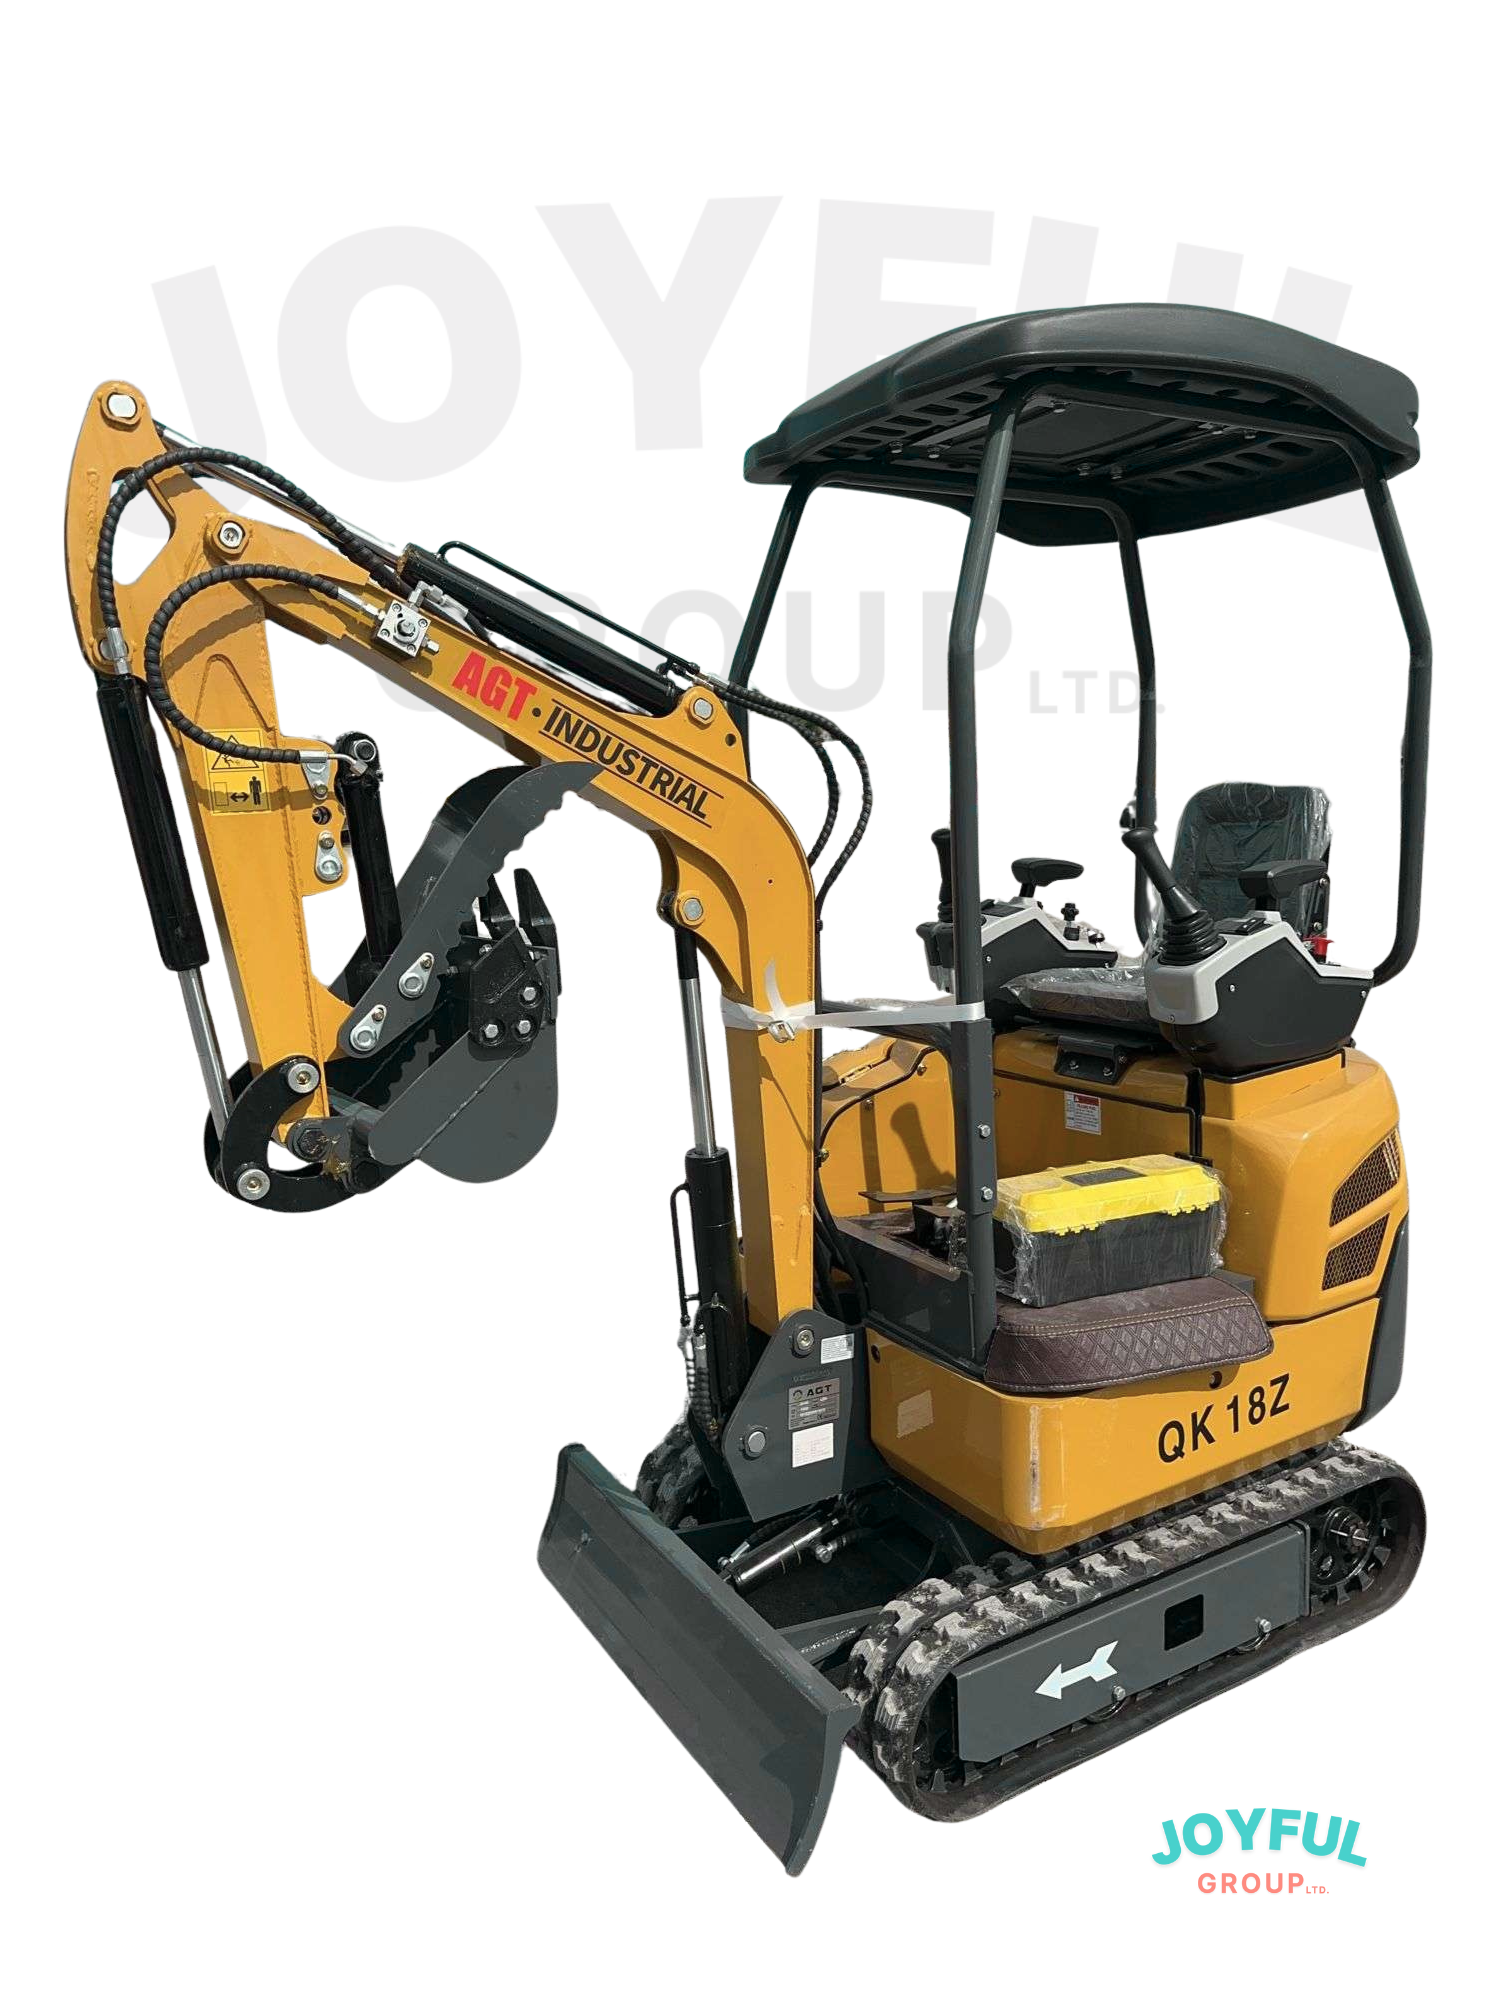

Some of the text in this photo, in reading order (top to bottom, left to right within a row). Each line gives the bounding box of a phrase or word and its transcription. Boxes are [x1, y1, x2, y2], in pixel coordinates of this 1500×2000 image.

[451, 650, 709, 819] AGT INDUSTRIAL
[807, 1384, 832, 1397] AGT
[1158, 1373, 1290, 1463] QK 18Z
